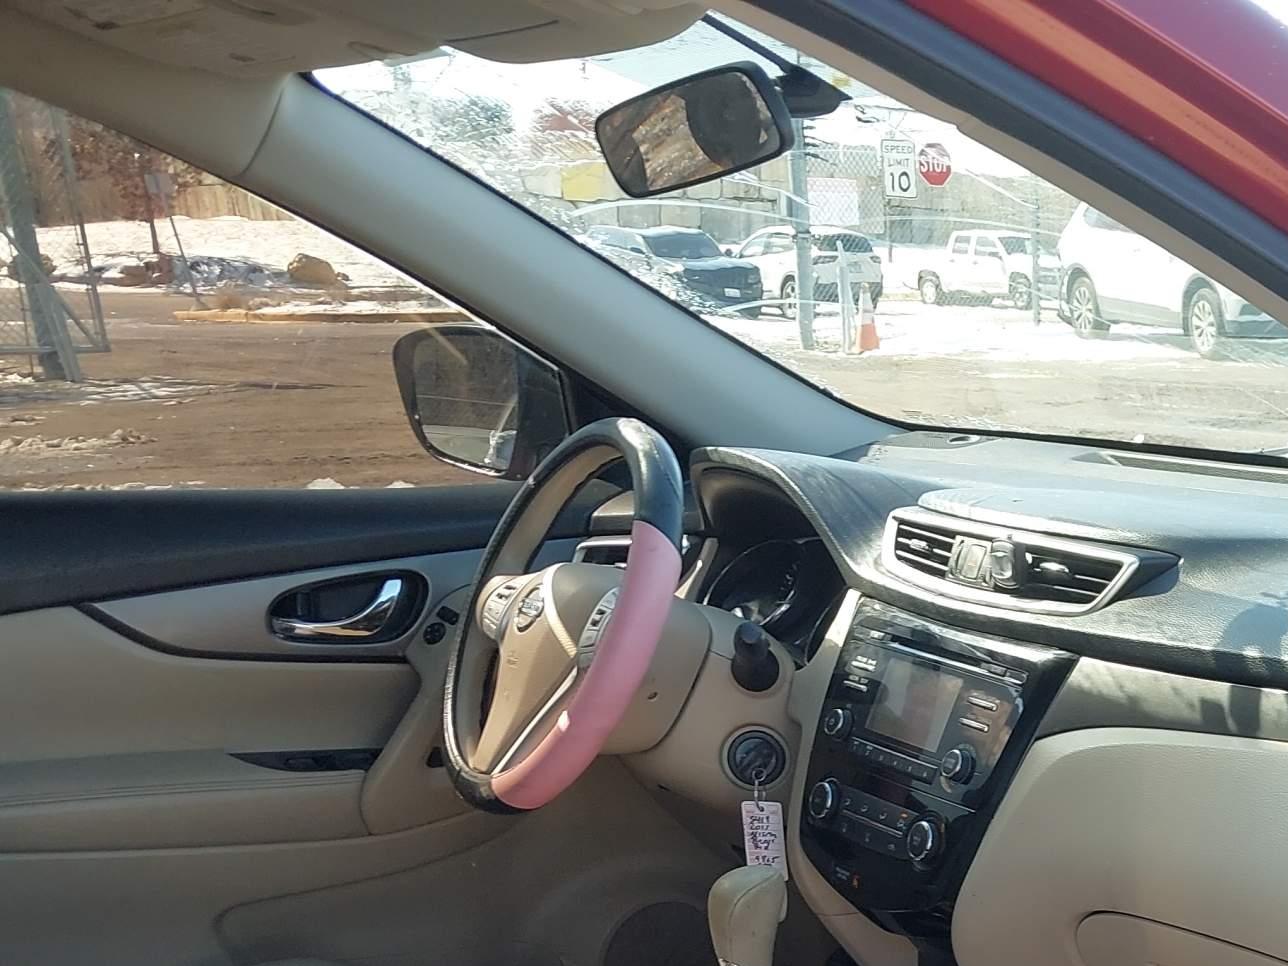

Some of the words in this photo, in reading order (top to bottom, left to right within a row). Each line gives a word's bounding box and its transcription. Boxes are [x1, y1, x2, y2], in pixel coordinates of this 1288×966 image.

[884, 144, 912, 154] SPEED
[888, 158, 910, 168] LIMIT
[920, 154, 947, 173] STOP
[889, 171, 911, 193] 10
